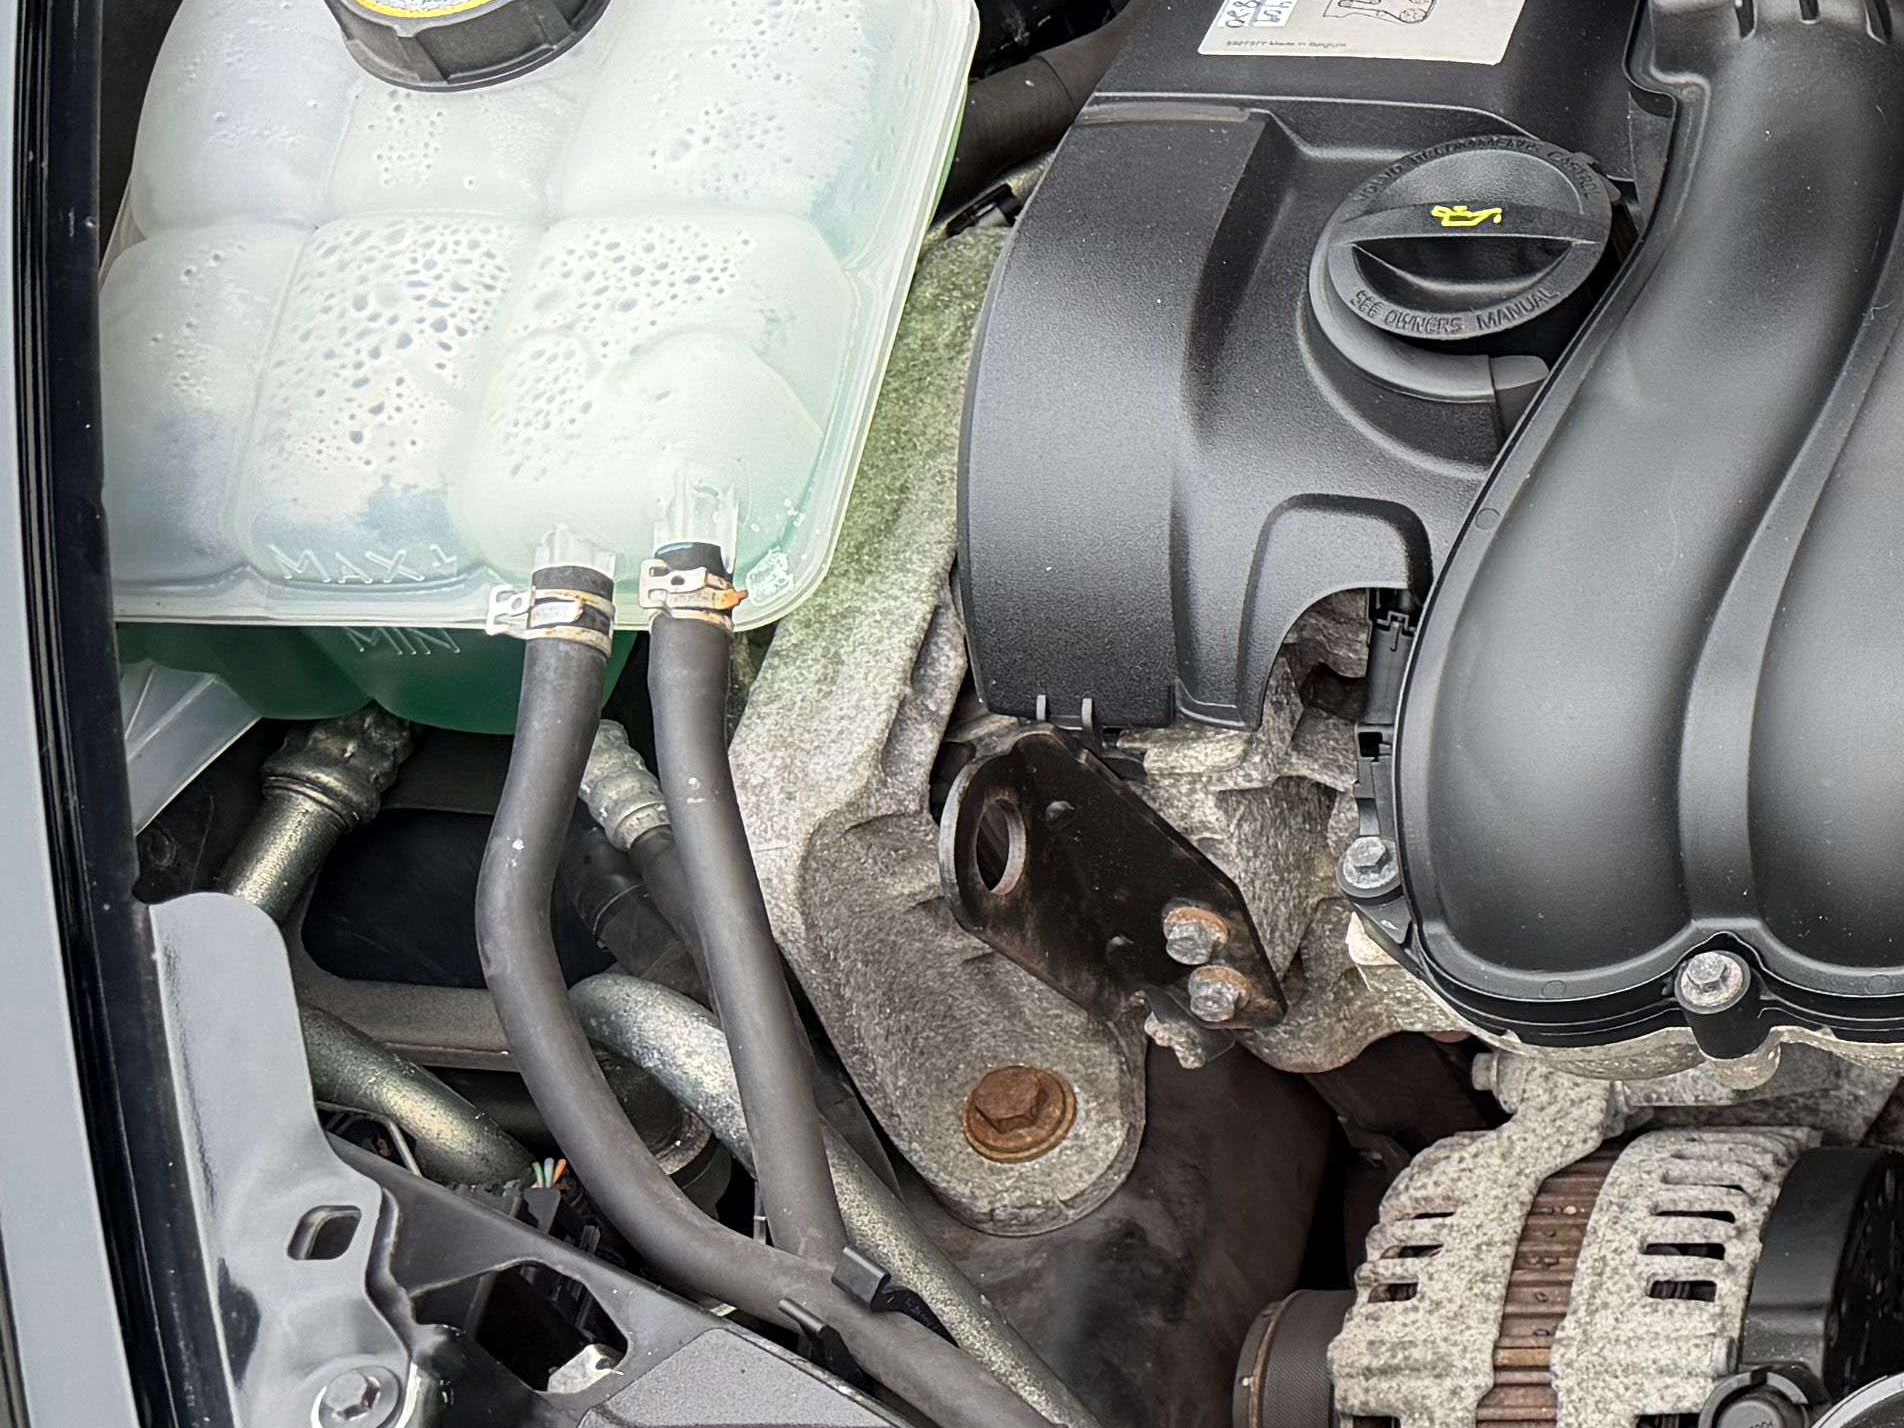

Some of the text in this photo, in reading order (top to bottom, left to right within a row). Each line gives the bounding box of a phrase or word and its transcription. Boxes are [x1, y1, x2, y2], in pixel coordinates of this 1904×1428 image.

[1349, 286, 1562, 335] SEE OWNERS MANUAL
